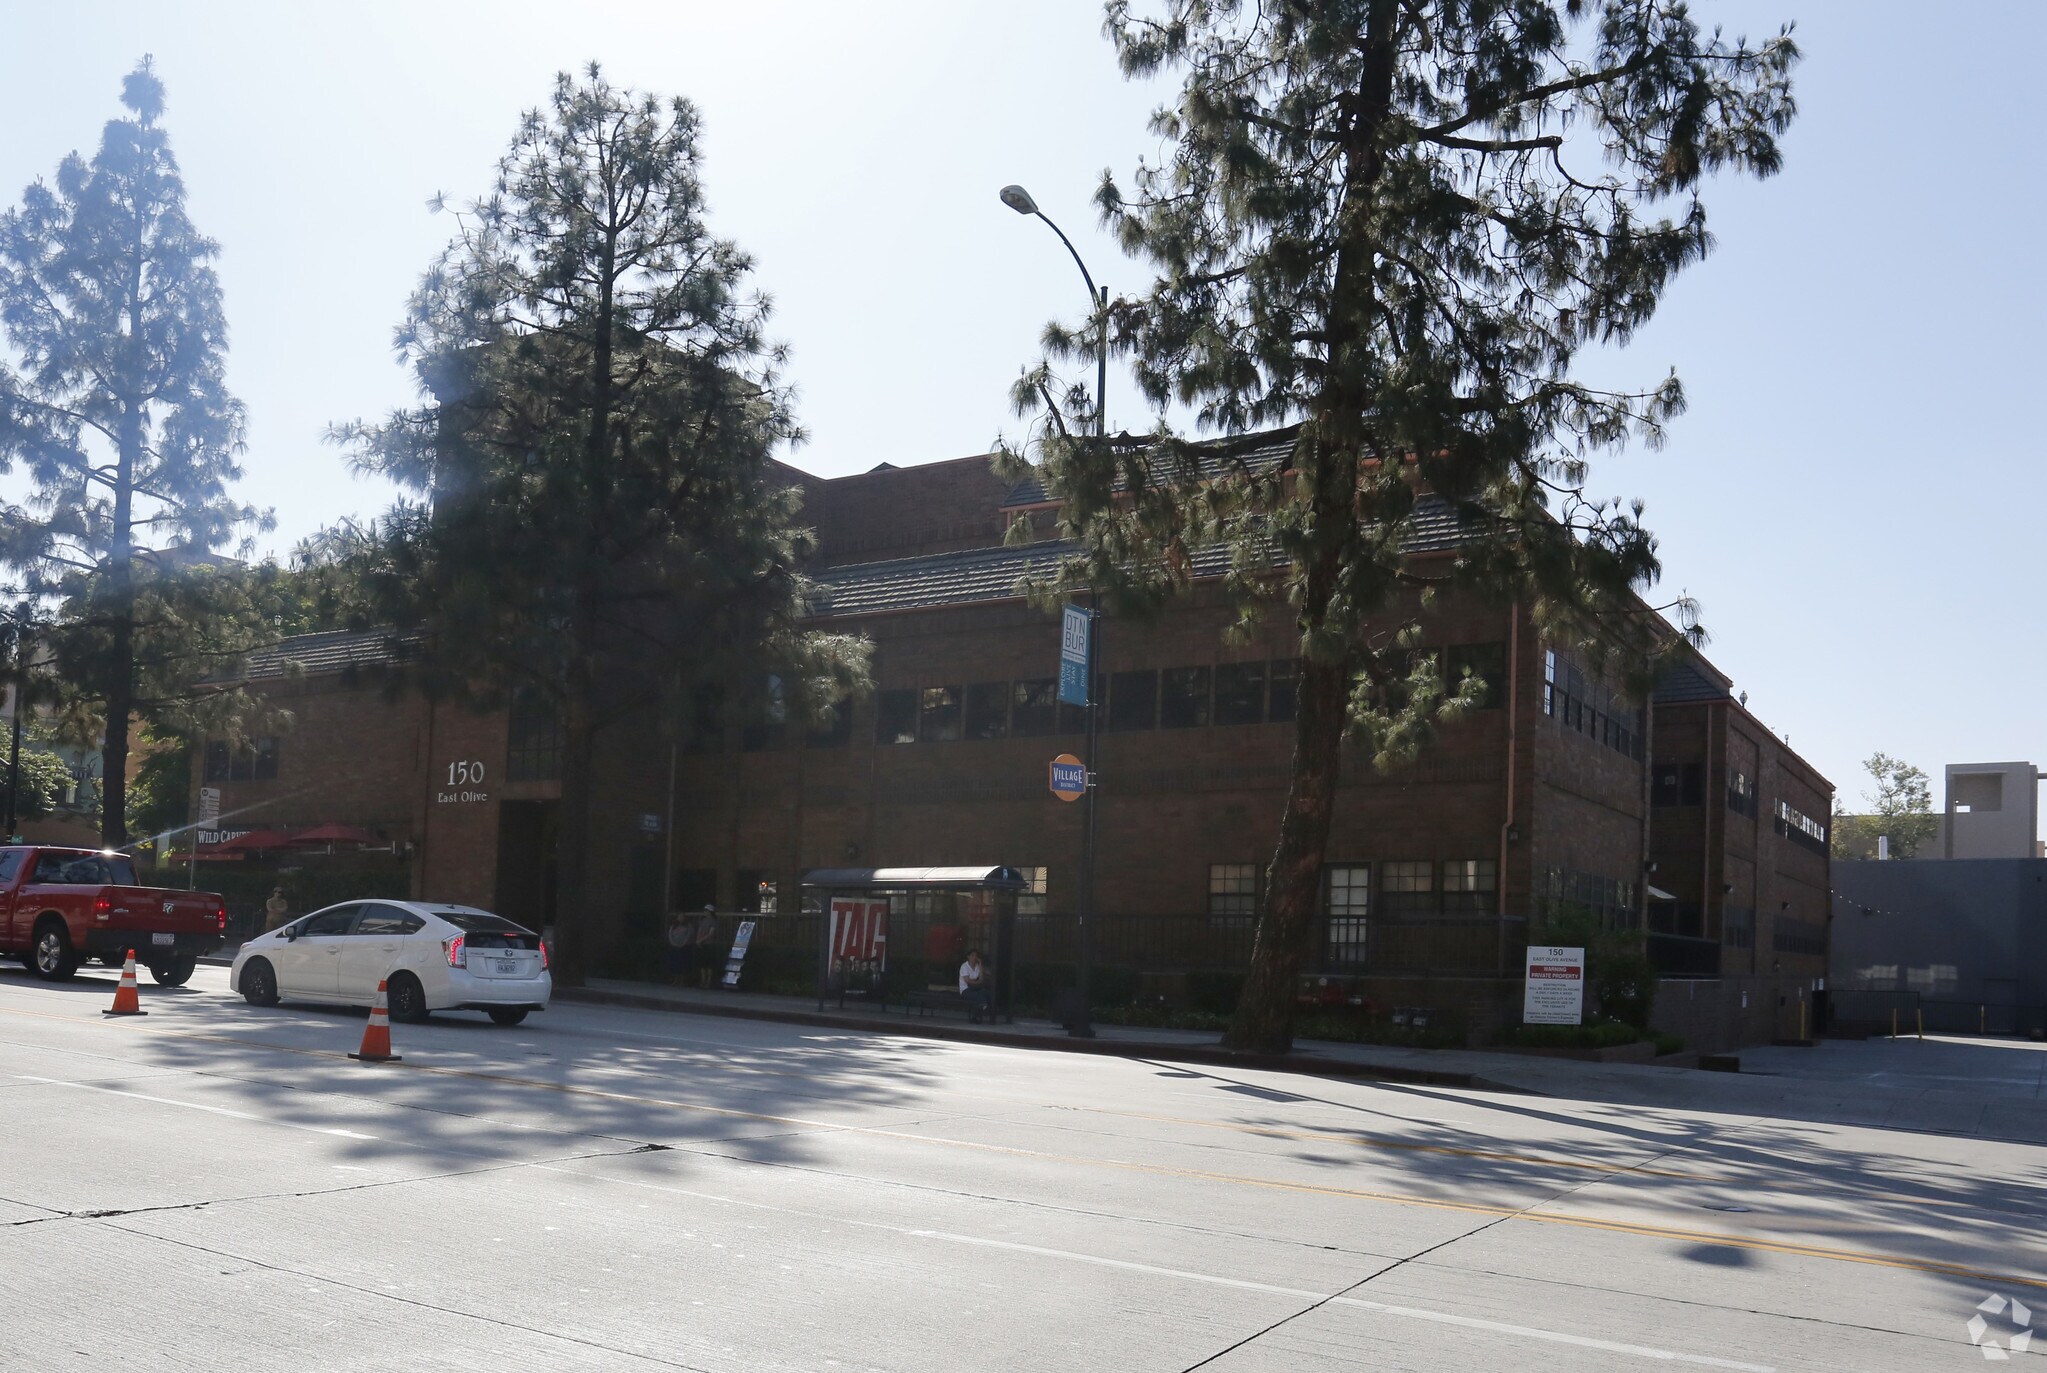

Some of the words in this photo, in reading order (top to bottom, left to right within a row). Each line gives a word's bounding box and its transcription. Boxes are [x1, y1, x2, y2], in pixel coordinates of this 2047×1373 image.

[1066, 614, 1086, 636] DTN
[1065, 631, 1085, 652] BUR
[1059, 663, 1067, 697] EXPLORE
[447, 760, 485, 786] 150
[1053, 767, 1083, 784] VILLAGE
[437, 792, 457, 803] East
[461, 791, 488, 802] Olive
[198, 830, 219, 844] WILD
[829, 902, 887, 964] TAG
